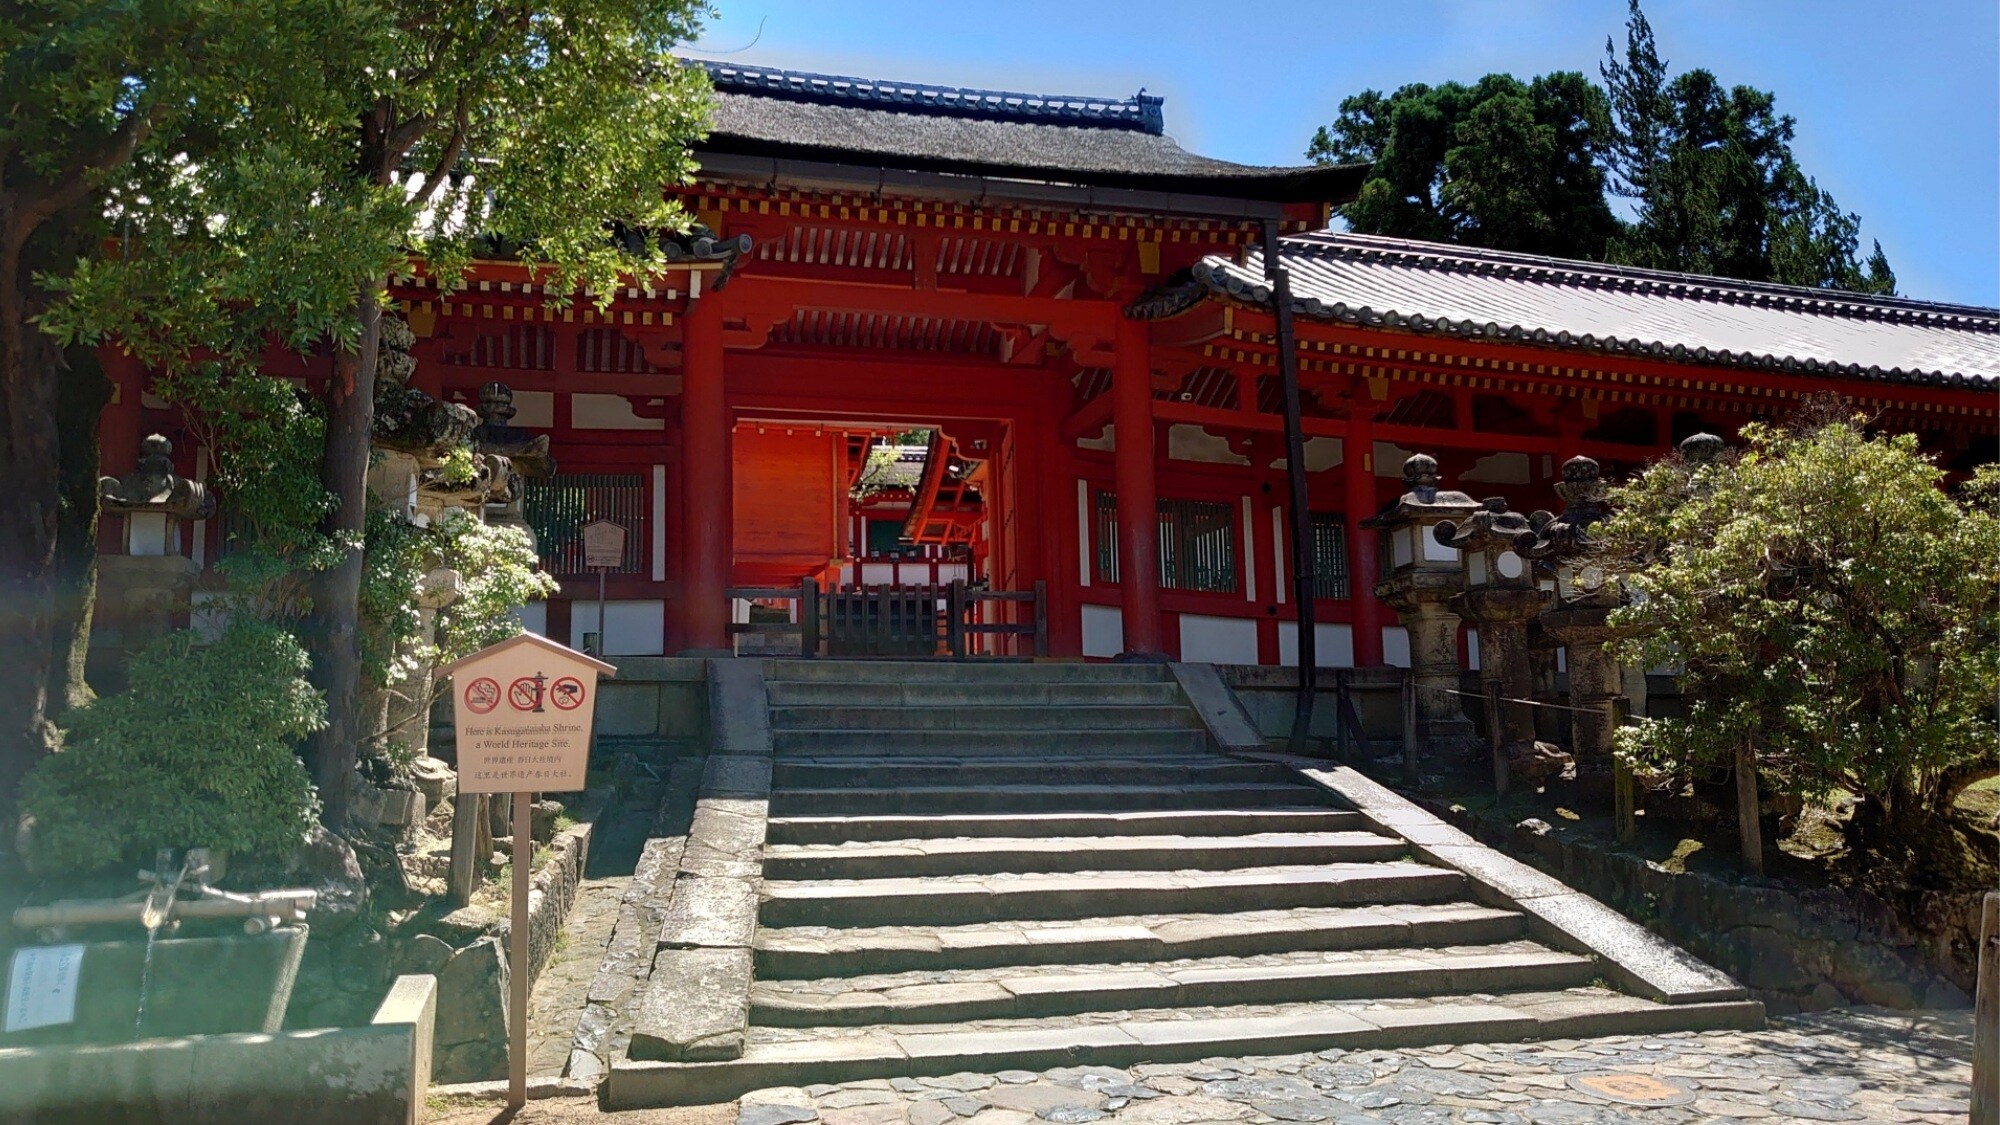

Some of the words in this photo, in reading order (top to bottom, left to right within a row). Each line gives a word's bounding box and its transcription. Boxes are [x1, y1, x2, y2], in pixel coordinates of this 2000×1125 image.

[465, 727, 485, 736] Here
[486, 727, 493, 736] is
[494, 724, 550, 737] Kasugataisha
[483, 740, 509, 749] World
[512, 739, 548, 750] Heritage
[551, 739, 571, 748] Site.
